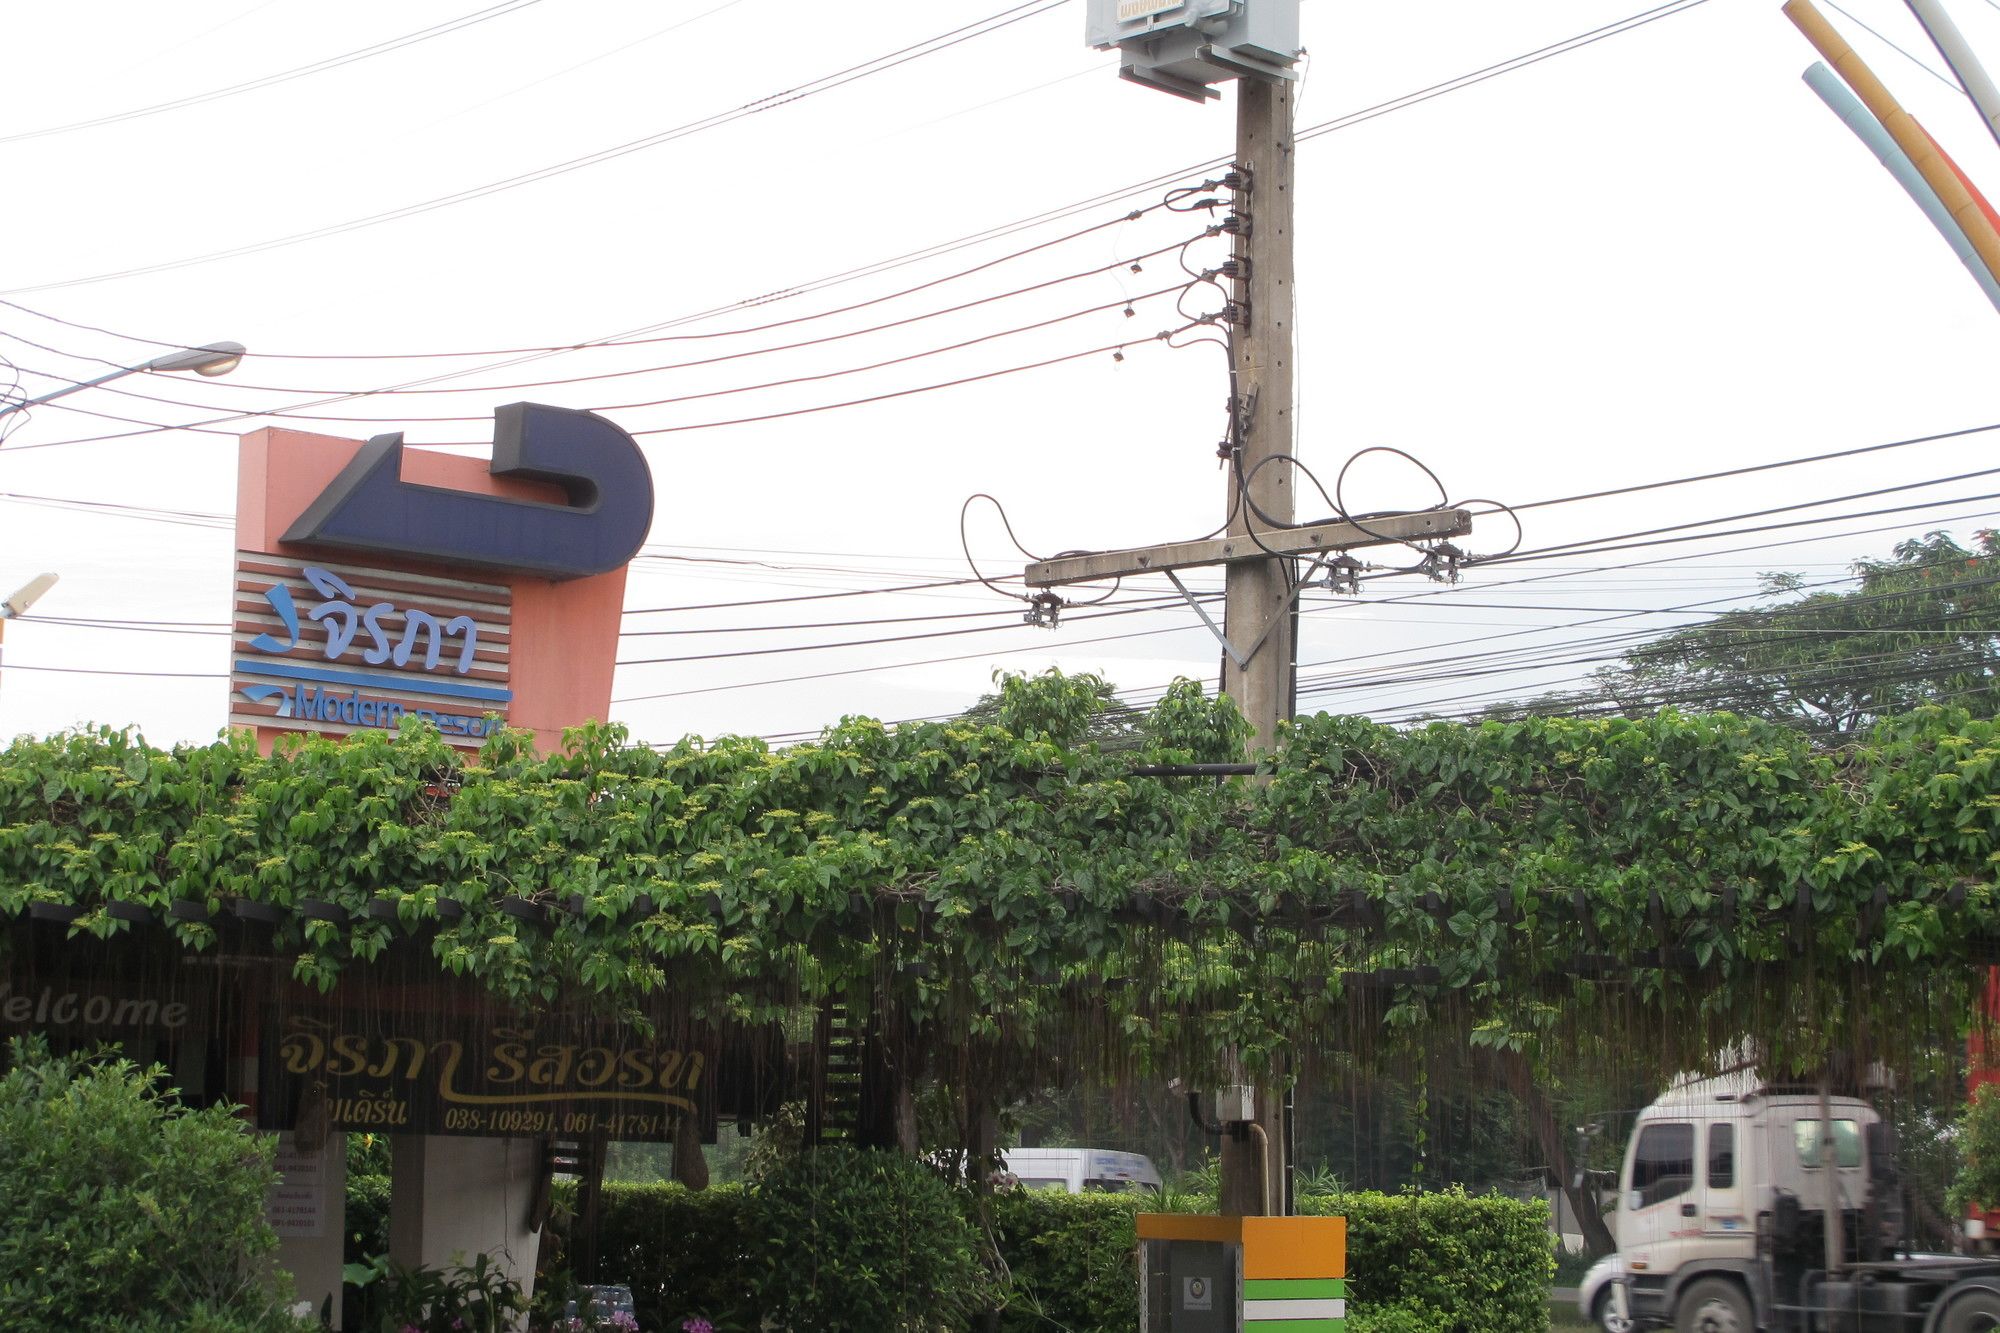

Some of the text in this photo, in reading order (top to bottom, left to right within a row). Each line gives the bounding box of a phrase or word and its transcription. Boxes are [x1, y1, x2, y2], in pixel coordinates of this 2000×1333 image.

[303, 566, 478, 674] จิรภา
[295, 684, 502, 738] Modern Reso
[0, 982, 188, 1027] elcome
